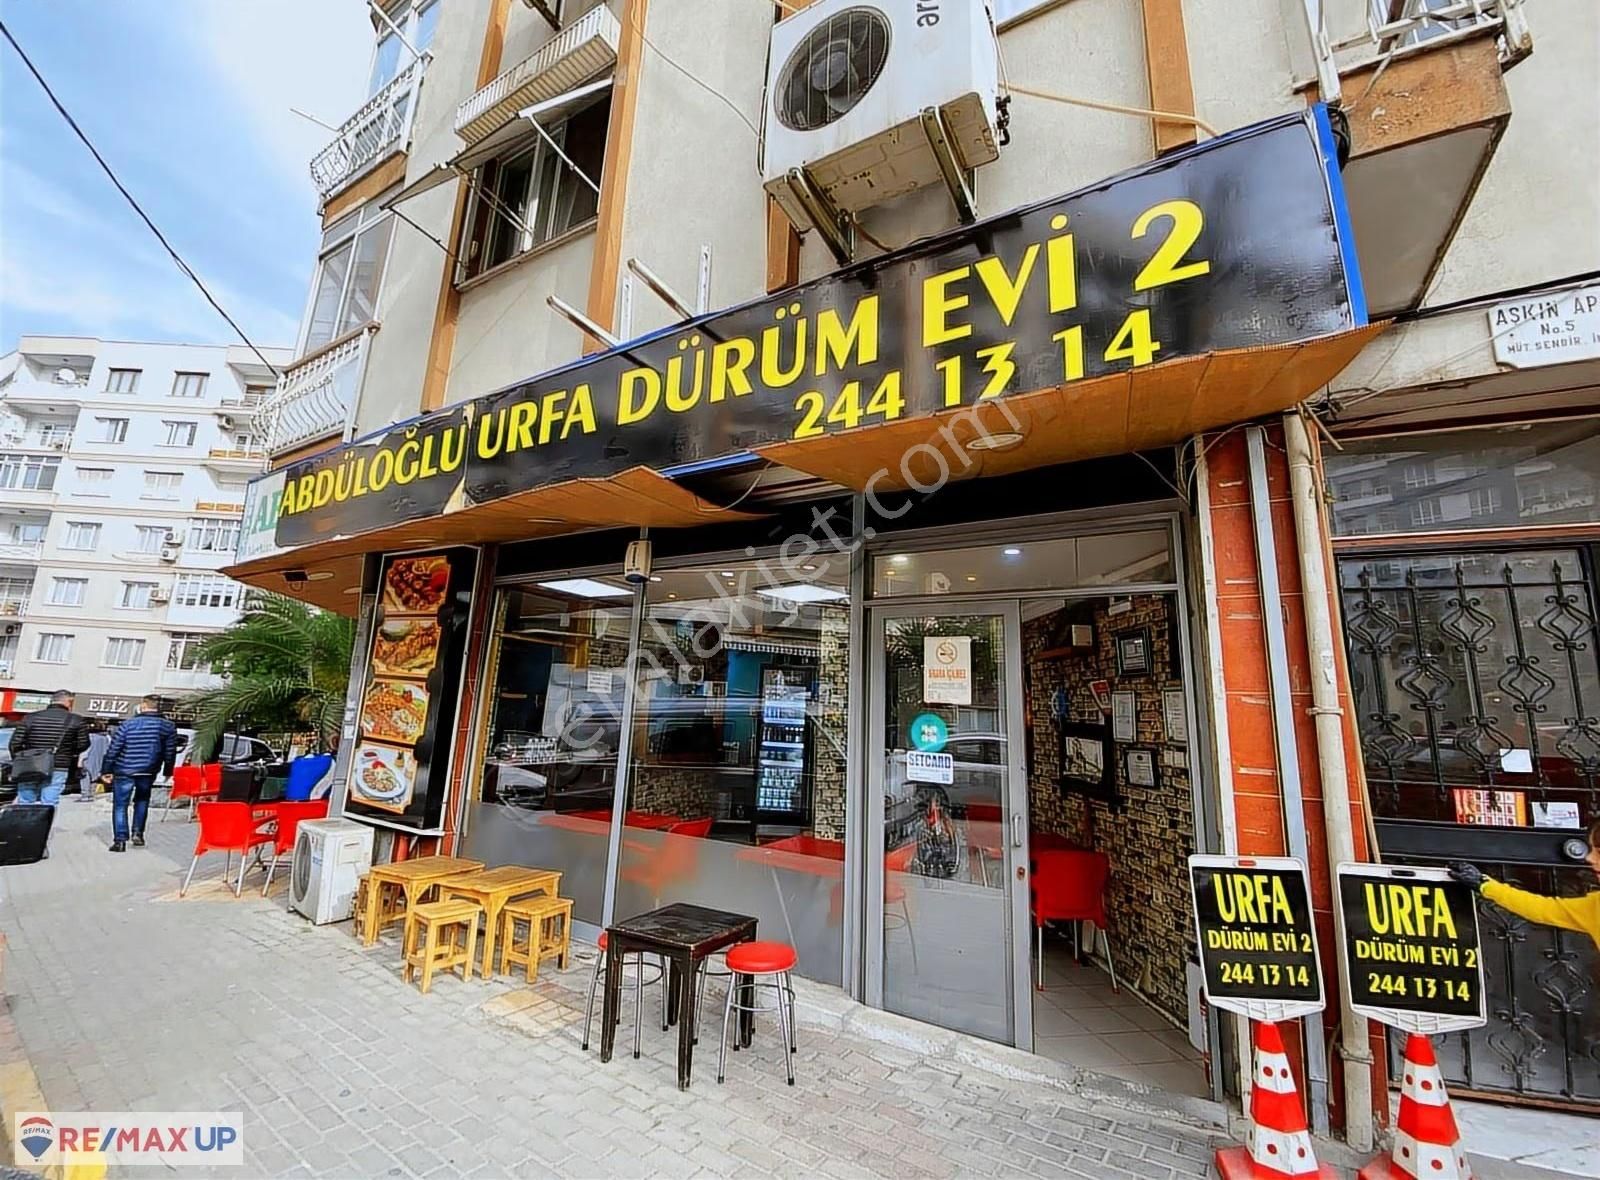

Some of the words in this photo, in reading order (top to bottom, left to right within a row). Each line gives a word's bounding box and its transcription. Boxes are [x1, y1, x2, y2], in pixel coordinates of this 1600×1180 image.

[916, 0, 940, 28] ar
[279, 424, 466, 517] ABDÜLOĞLU
[479, 384, 597, 459] URFA
[616, 295, 879, 425] DÜRÜM
[922, 214, 1079, 348] EVİ
[1131, 199, 1210, 292] 2
[793, 370, 905, 440] 244
[935, 342, 1016, 407] 13
[1052, 308, 1160, 381] 14
[88, 696, 129, 713] ELİZ
[909, 753, 951, 769] SETCARD
[1212, 873, 1295, 924] URFA
[1364, 883, 1457, 939] URFA
[1207, 927, 1269, 952] DÜRÜM
[1272, 928, 1296, 953] EVİ
[1301, 932, 1313, 953] 2
[1356, 938, 1424, 965] DÜRÜM
[1431, 943, 1459, 966] EVİ
[1465, 947, 1478, 968] 2
[1220, 961, 1254, 985] 244
[1259, 964, 1280, 987] 13
[1286, 965, 1310, 987] 14
[1368, 972, 1406, 996] 244
[1414, 978, 1438, 998] 13
[1444, 979, 1471, 1002] 14
